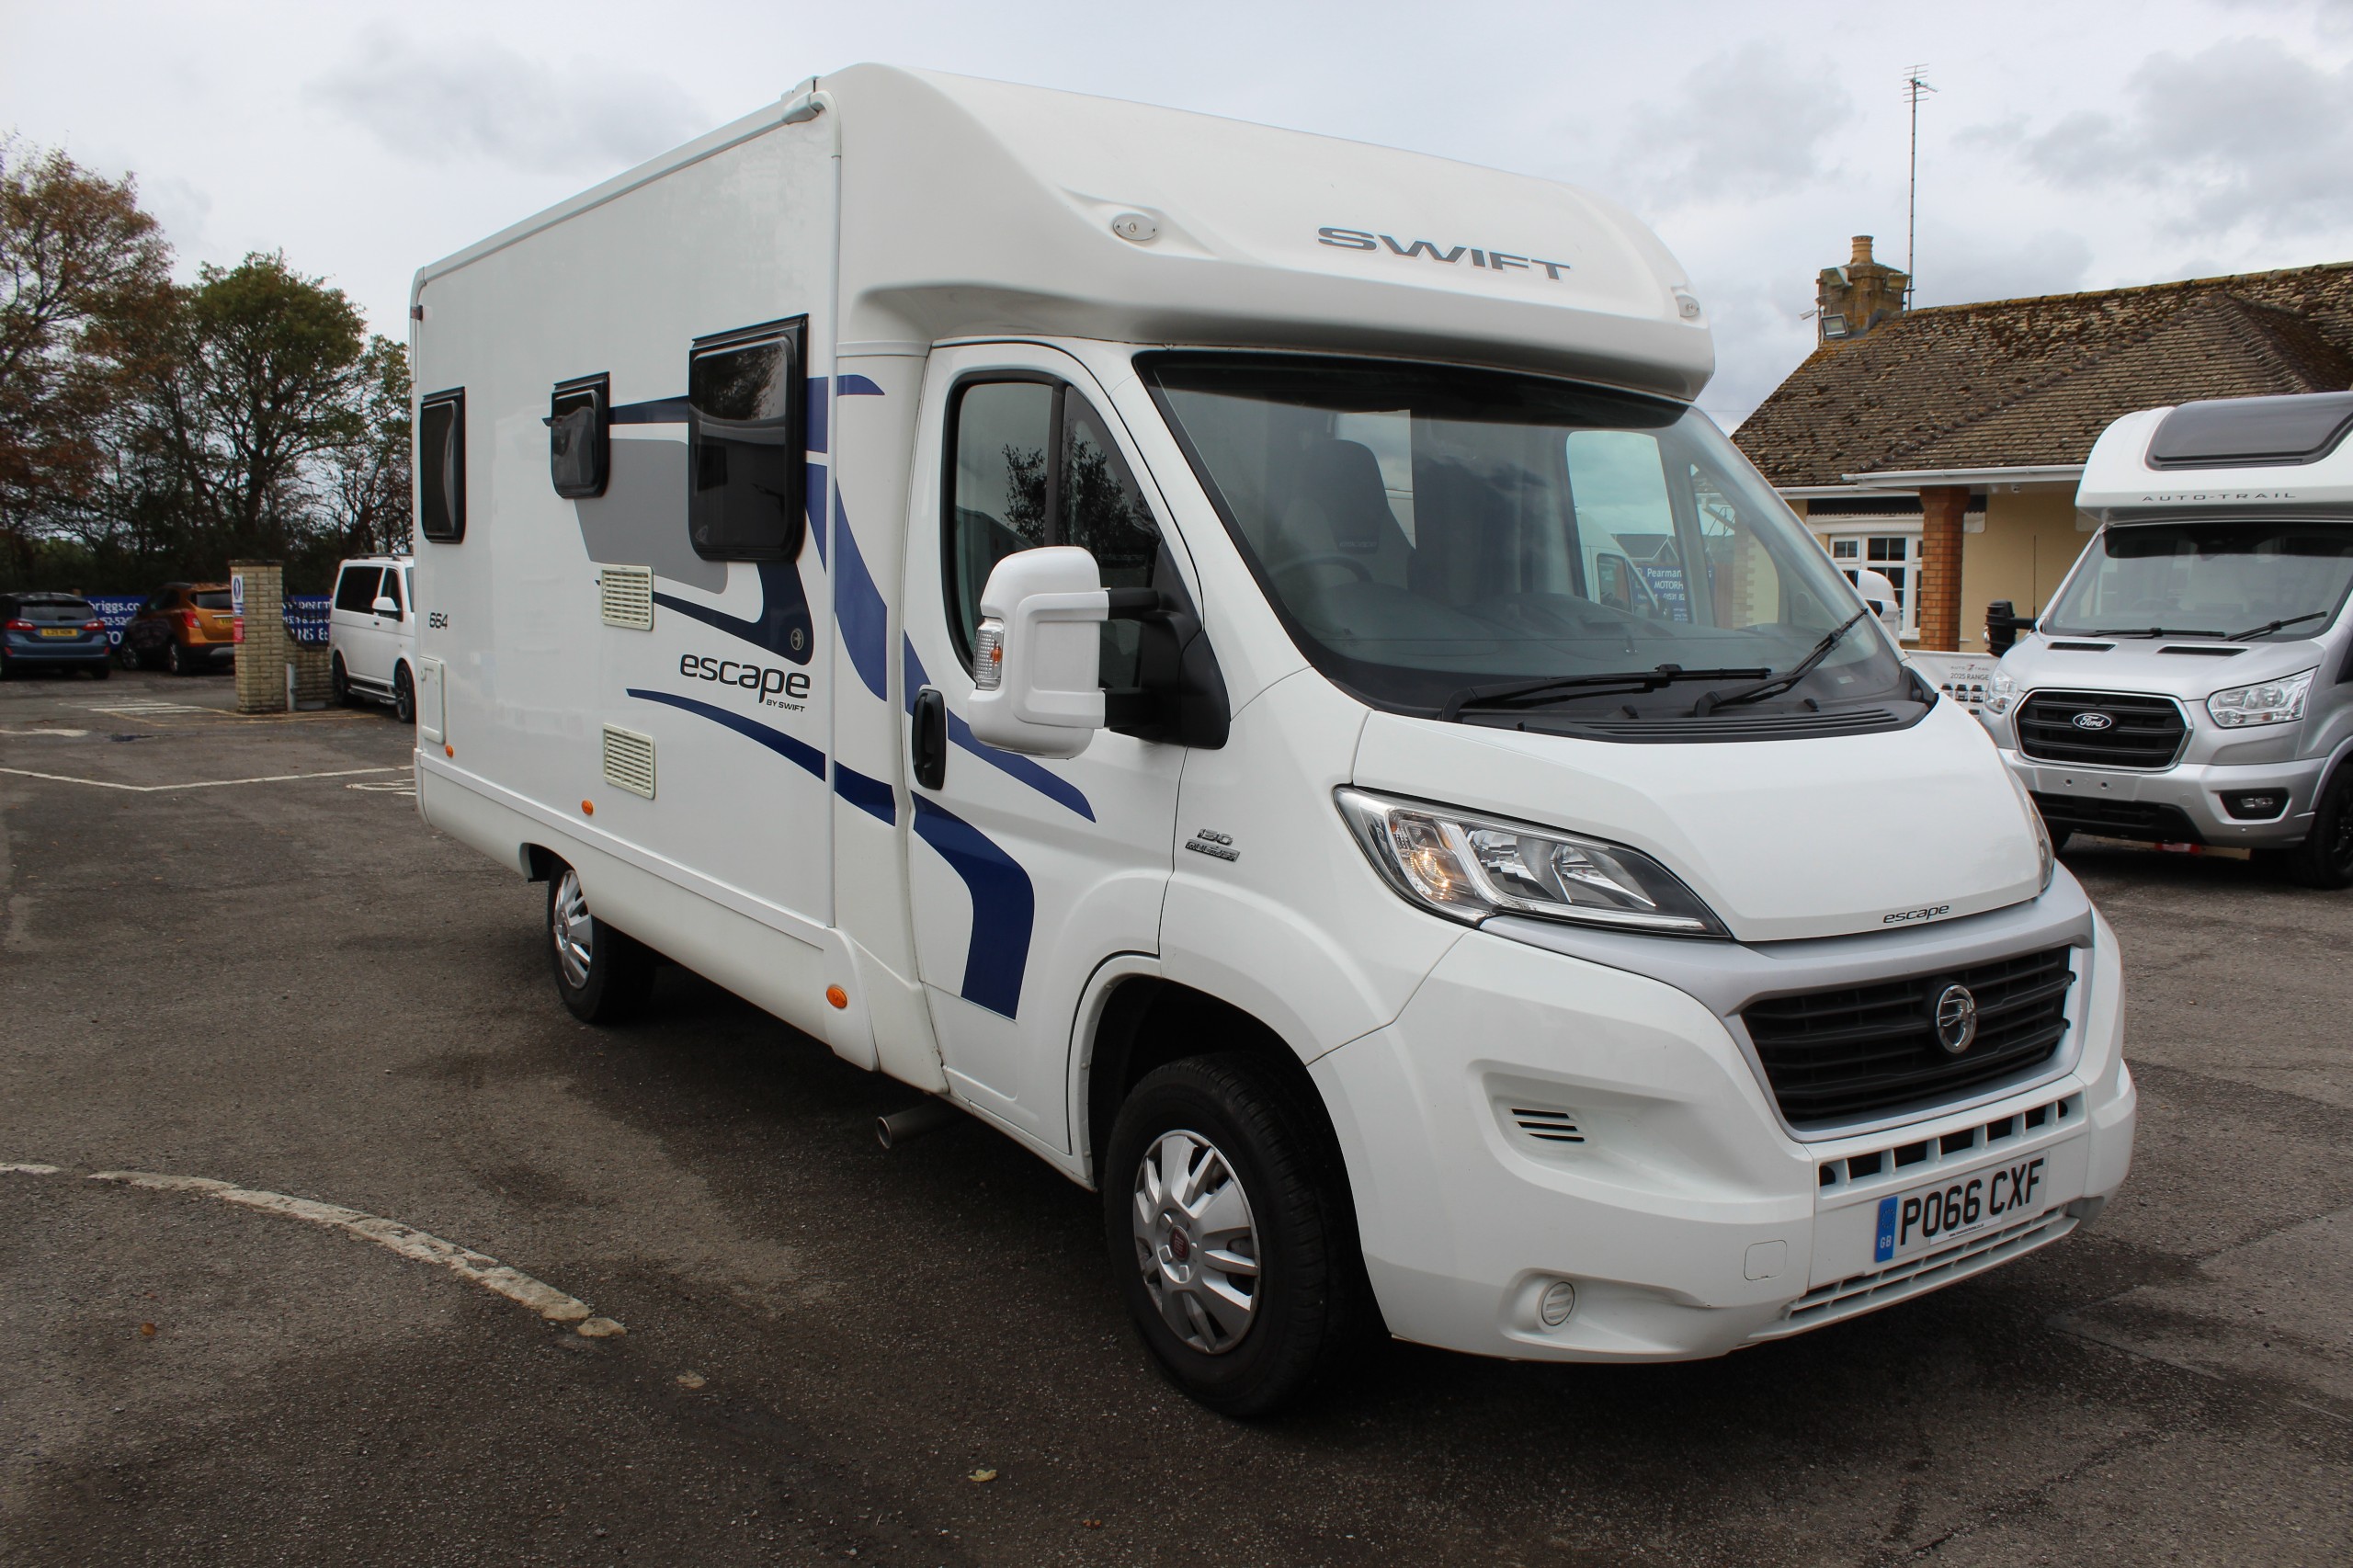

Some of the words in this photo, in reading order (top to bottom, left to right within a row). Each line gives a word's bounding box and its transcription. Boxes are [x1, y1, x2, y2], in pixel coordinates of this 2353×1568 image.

[1317, 226, 1571, 281] SWIFT
[2143, 493, 2296, 501] AUTO-TRAIL
[1647, 567, 1682, 578] Pearman
[429, 612, 448, 631] 664
[680, 654, 811, 704] escape
[779, 701, 806, 712] SWIFT
[2079, 715, 2105, 727] Ford
[1883, 904, 1949, 924] escape
[1900, 1178, 1983, 1245] PO66
[1989, 1157, 2044, 1216] CXF
[1880, 1234, 1892, 1249] GB
